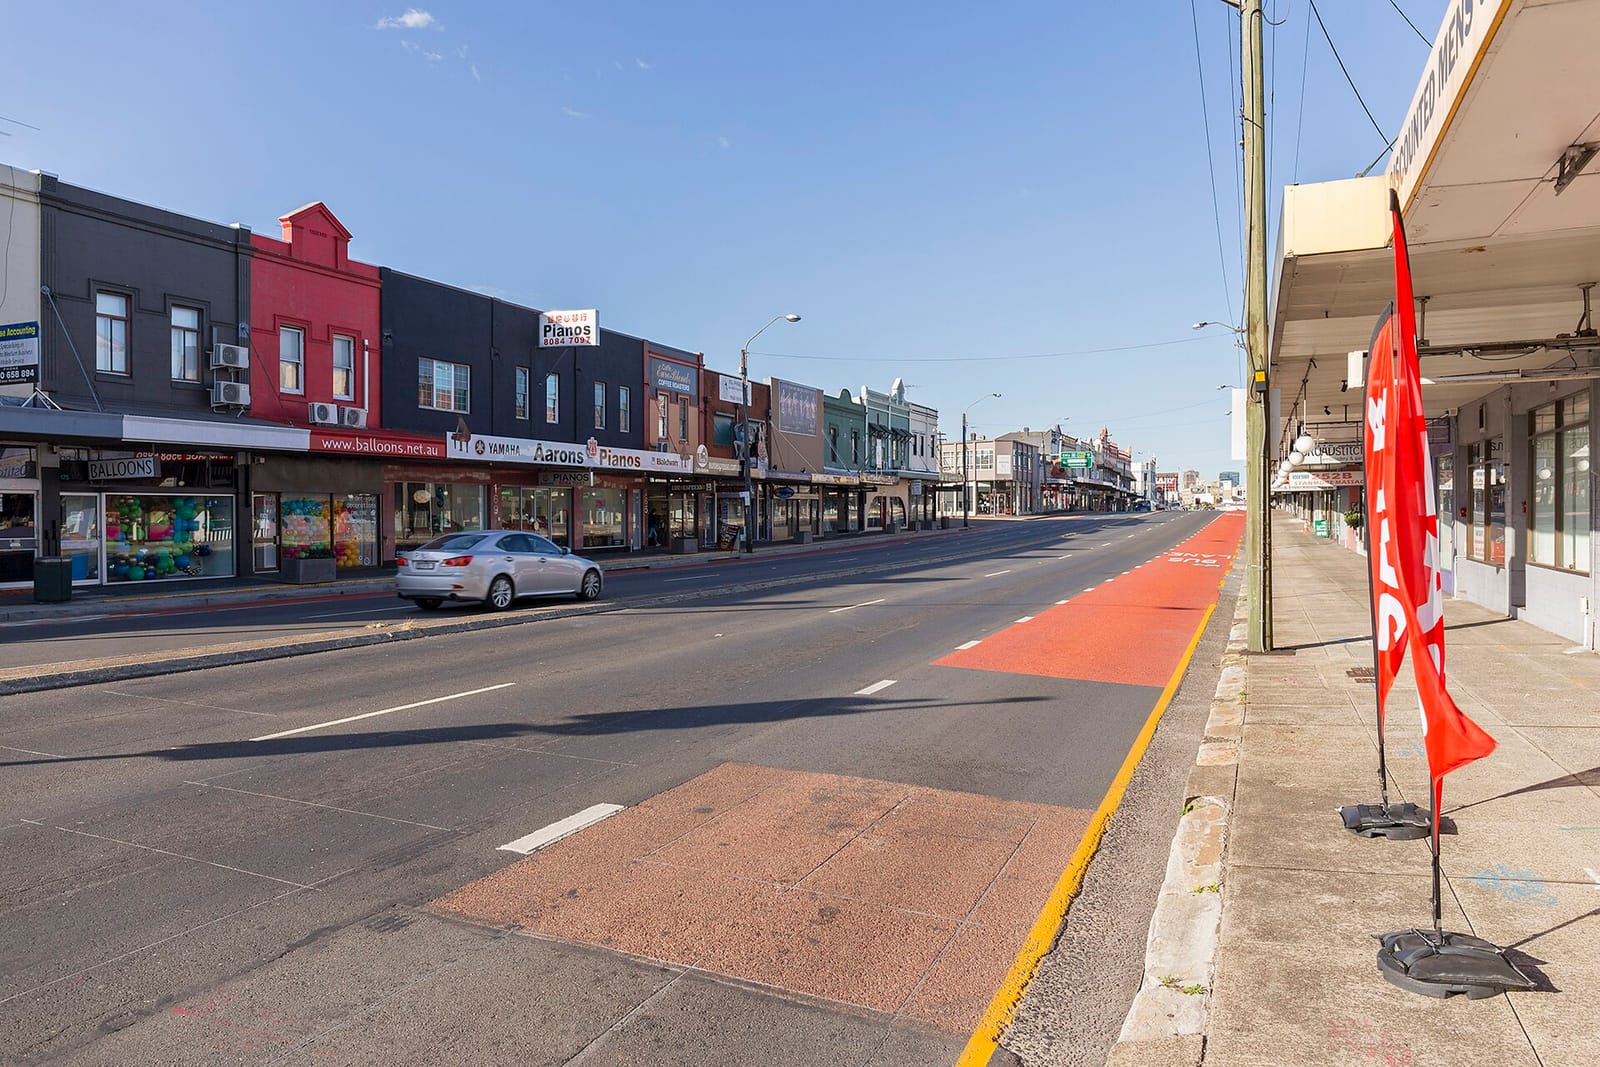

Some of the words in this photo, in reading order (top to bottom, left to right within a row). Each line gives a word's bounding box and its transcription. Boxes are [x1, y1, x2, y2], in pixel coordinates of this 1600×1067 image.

[1438, 0, 1473, 98] MENS
[7, 326, 36, 337] Accounting
[543, 324, 591, 338] Pianos
[543, 338, 565, 346] 8084
[568, 336, 591, 345] 7097
[6, 371, 20, 379] 658
[21, 369, 35, 378] 894
[322, 436, 438, 457] www.balloons.net.au
[488, 442, 520, 457] YAMAHA
[533, 443, 584, 465] Aarons
[599, 449, 641, 468] Pianos
[90, 459, 153, 479] BALLOONS
[553, 473, 590, 482] PIANOS
[1311, 472, 1353, 480] 252B
[1168, 551, 1232, 559] LANE
